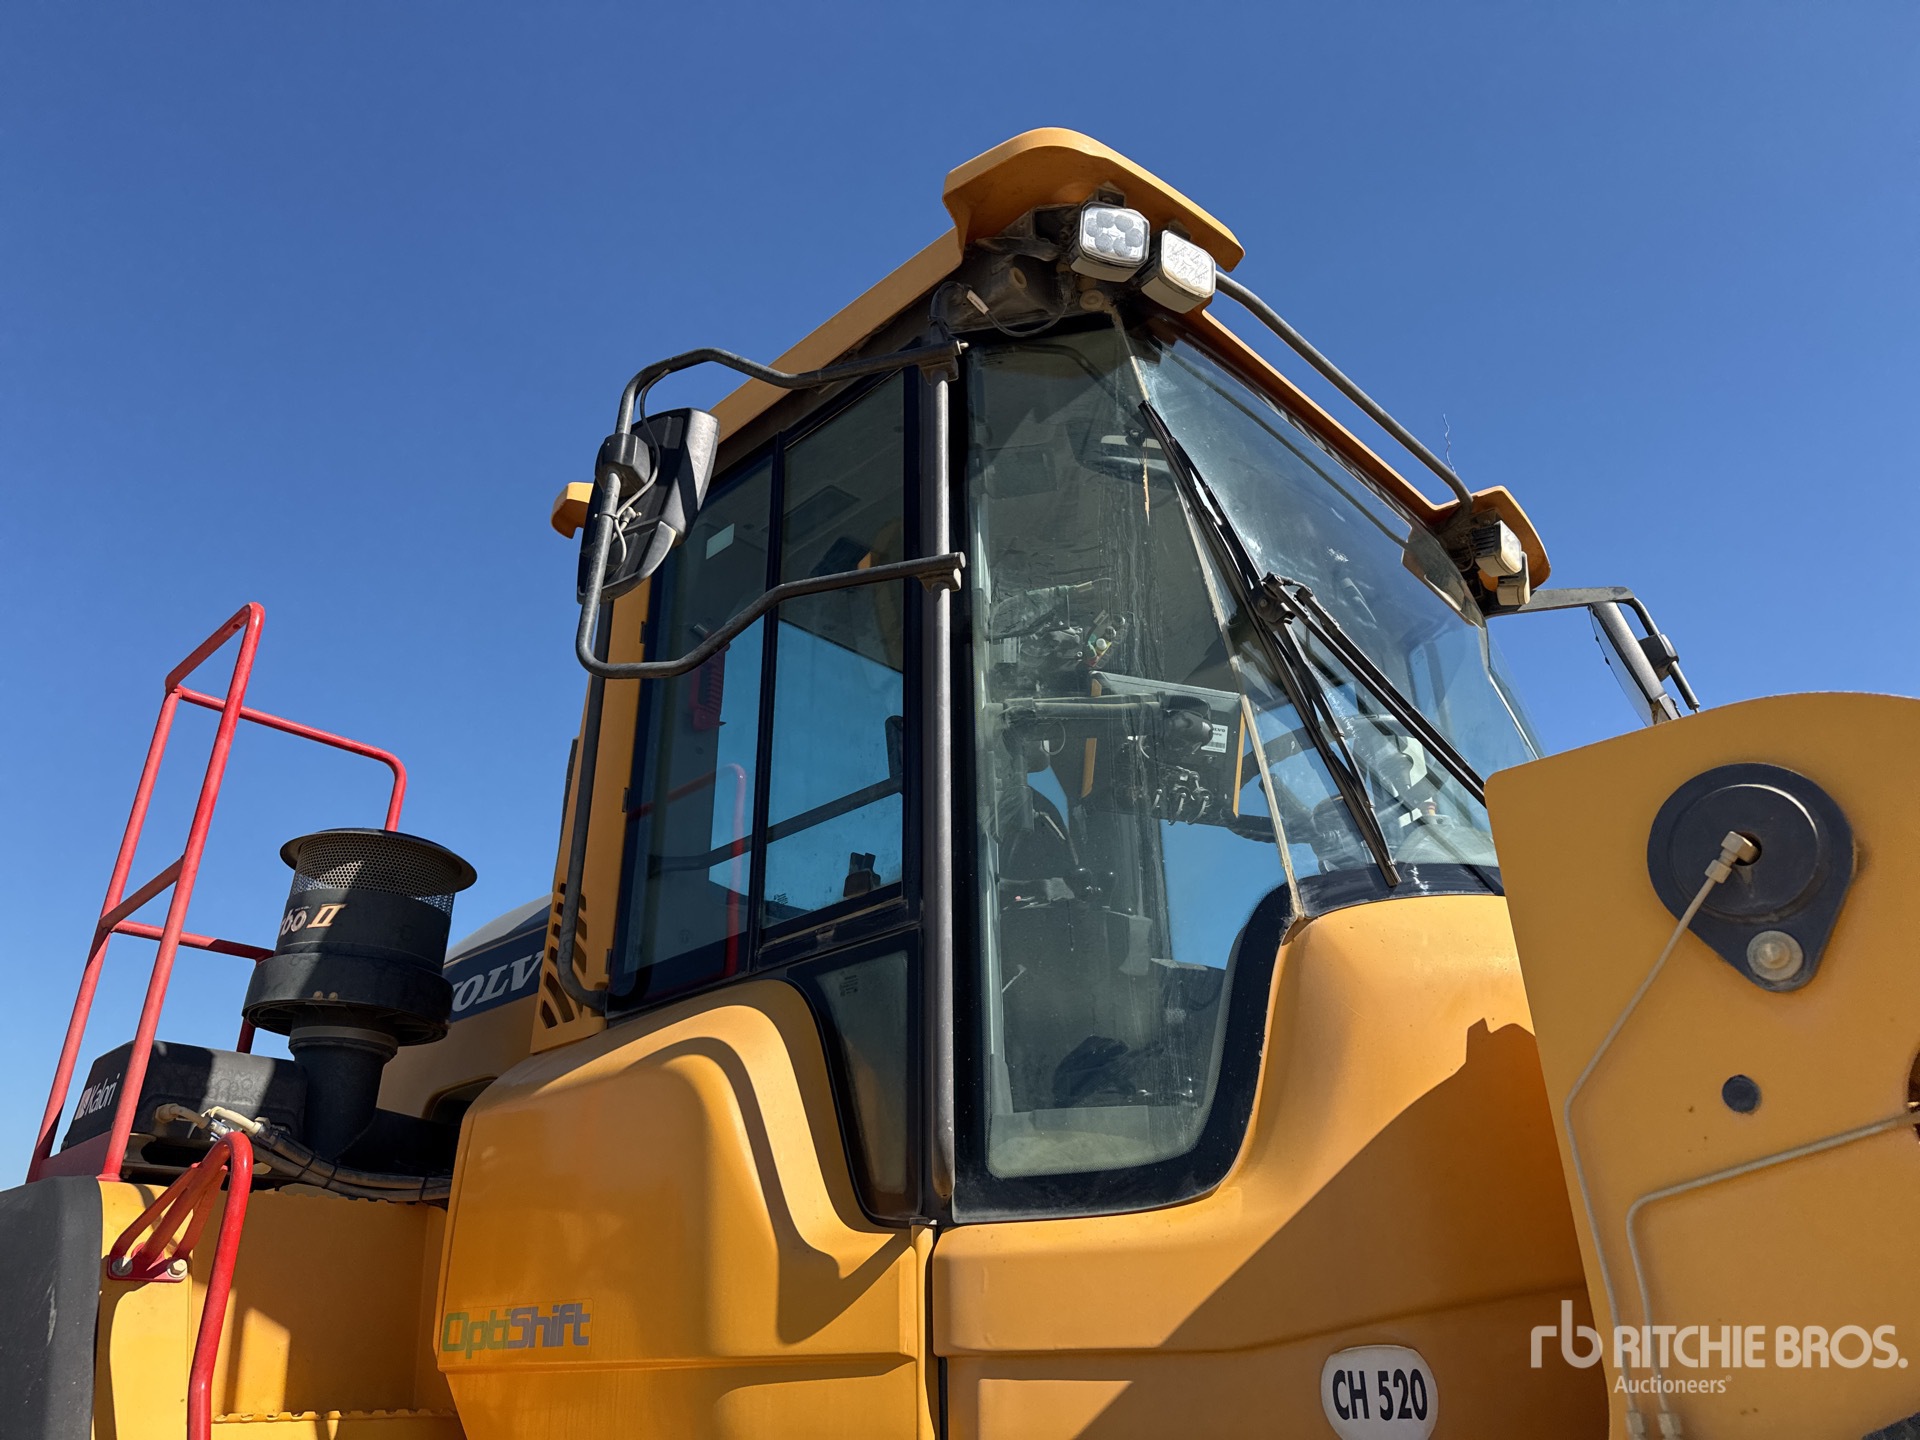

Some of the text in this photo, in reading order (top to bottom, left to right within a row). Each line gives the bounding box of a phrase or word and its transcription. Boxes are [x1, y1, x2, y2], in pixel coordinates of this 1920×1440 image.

[453, 950, 544, 1012] OLV
[442, 1302, 591, 1359] OptiShift
[1332, 1368, 1428, 1421] CH 520
